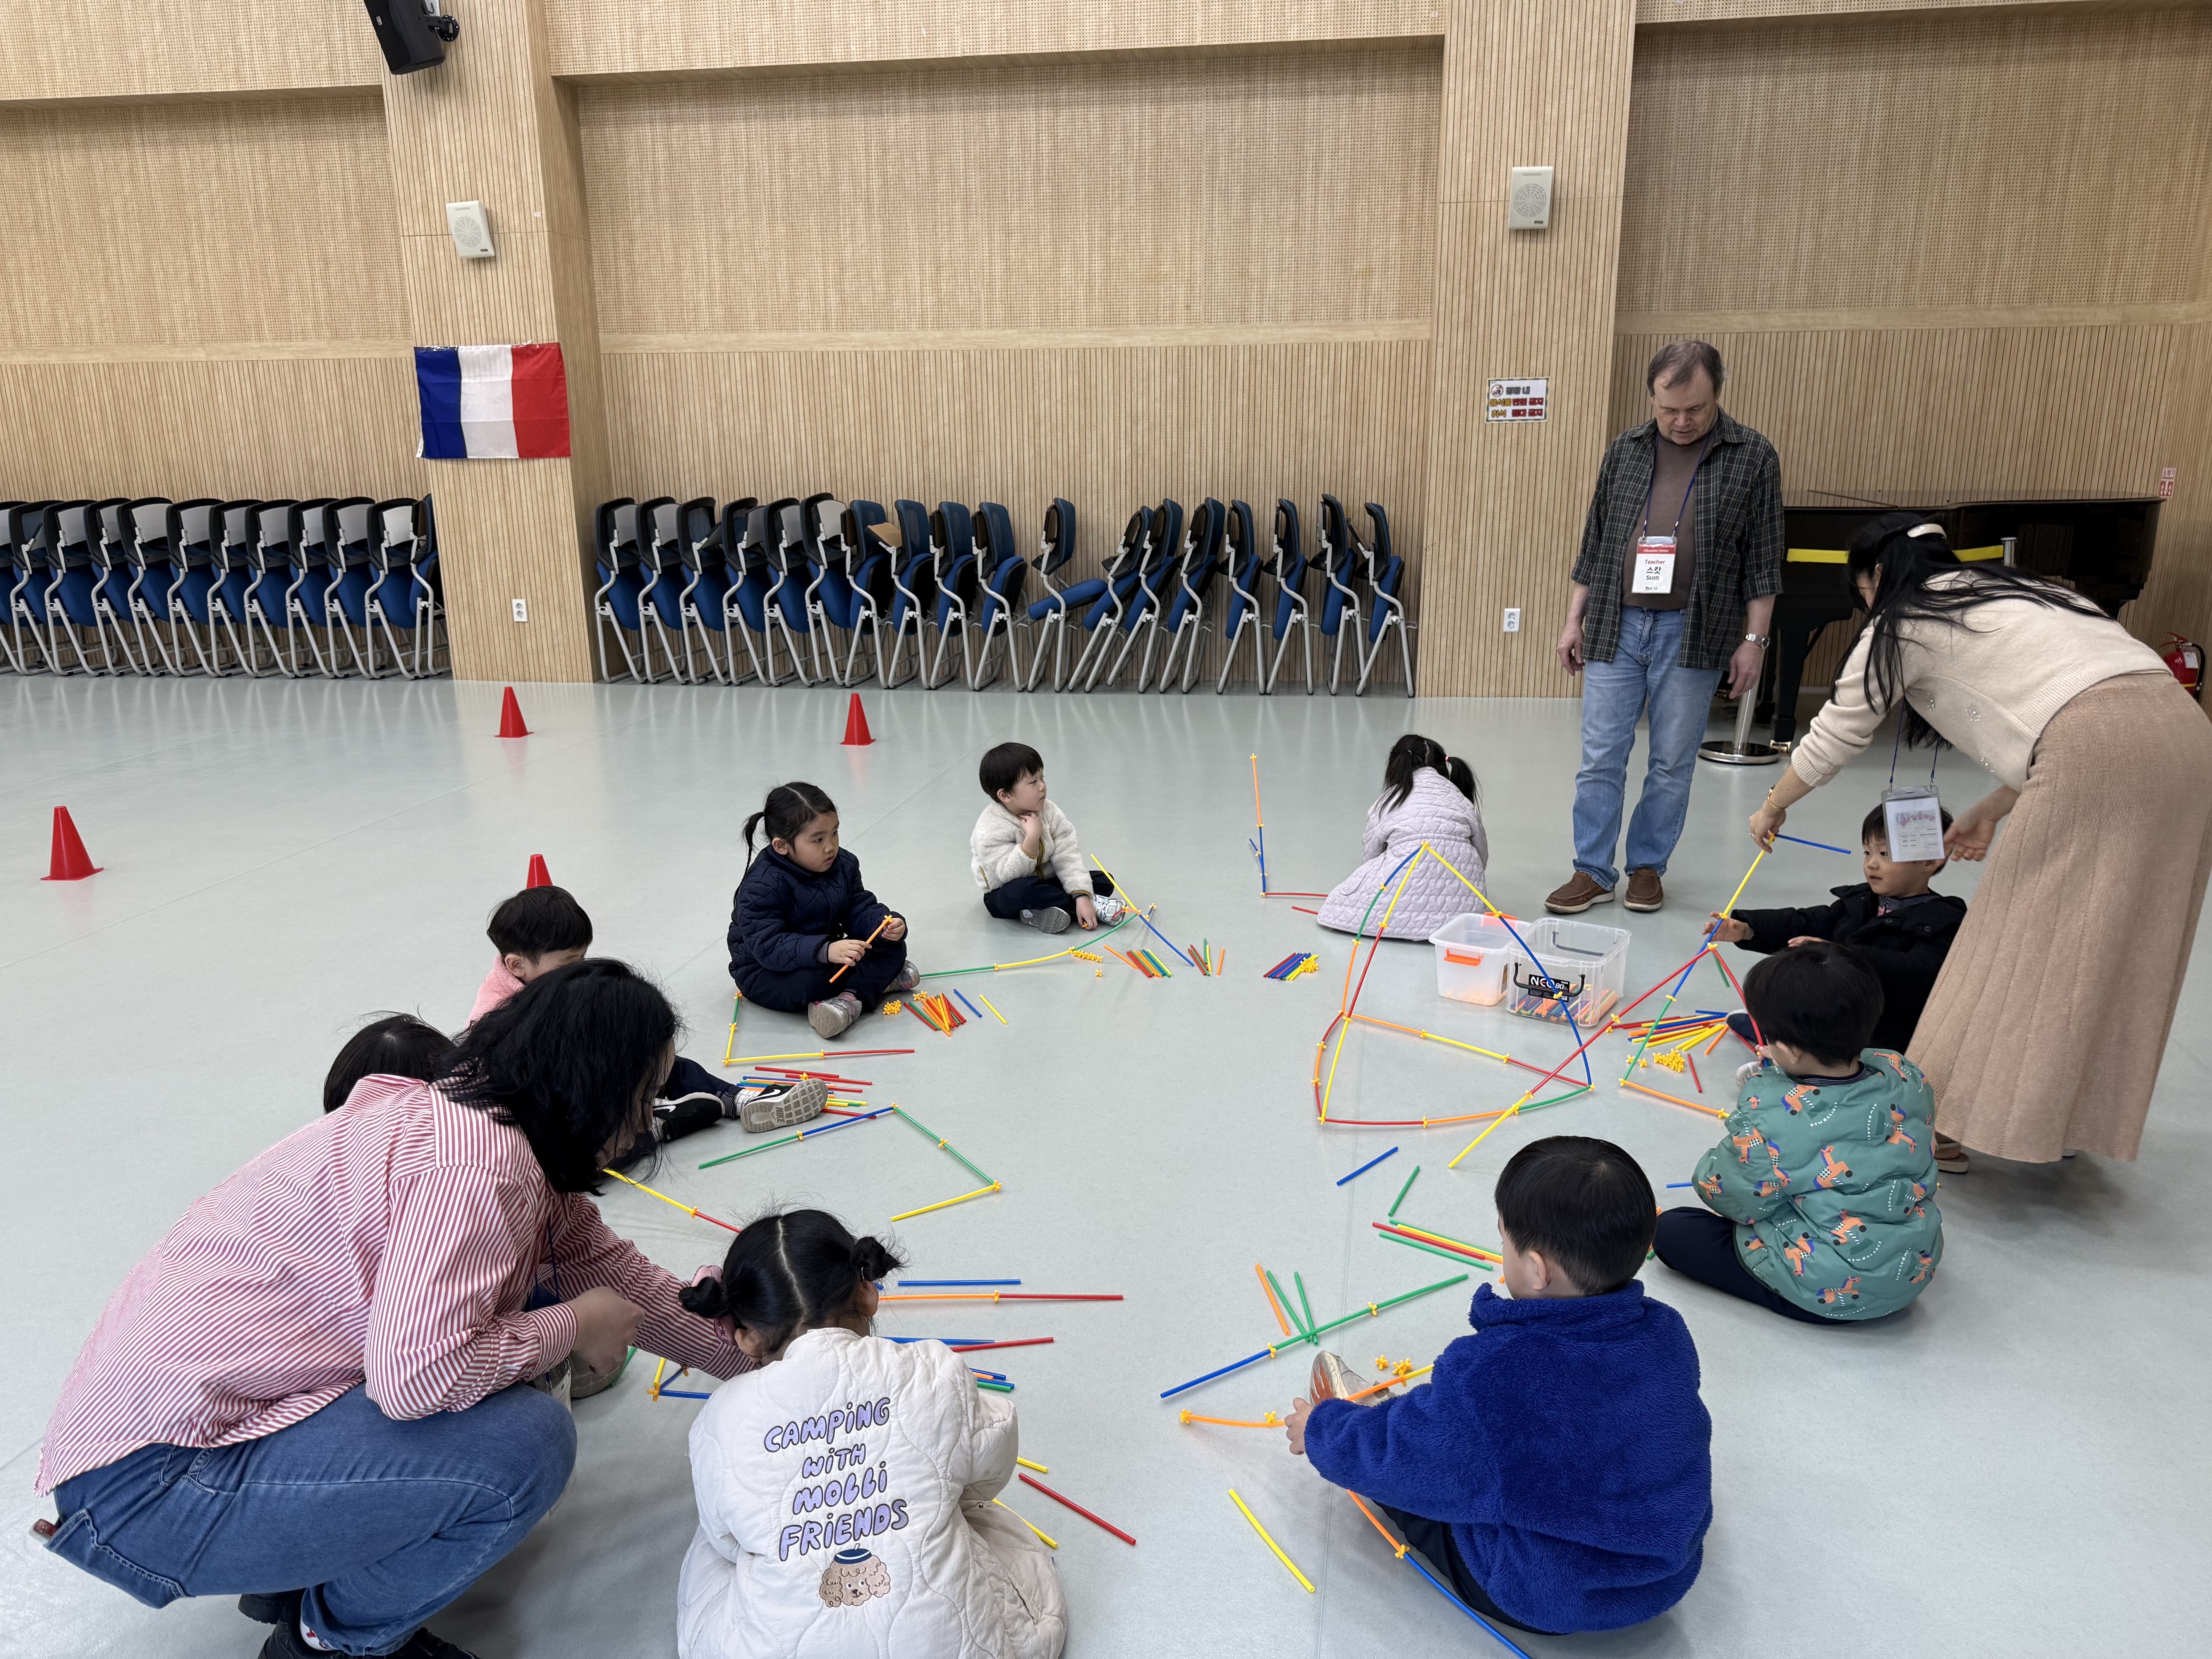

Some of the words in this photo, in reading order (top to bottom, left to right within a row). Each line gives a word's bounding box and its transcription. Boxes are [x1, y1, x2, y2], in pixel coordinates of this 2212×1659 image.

[1522, 386, 1530, 395] 내
[1489, 398, 1511, 407] 음식물
[1512, 398, 1527, 406] 반입
[1529, 397, 1544, 406] 금지
[1492, 409, 1506, 418] 취식
[1528, 409, 1543, 417] 금지
[1530, 976, 1555, 988] NEO
[776, 1107, 785, 1123] NIKE
